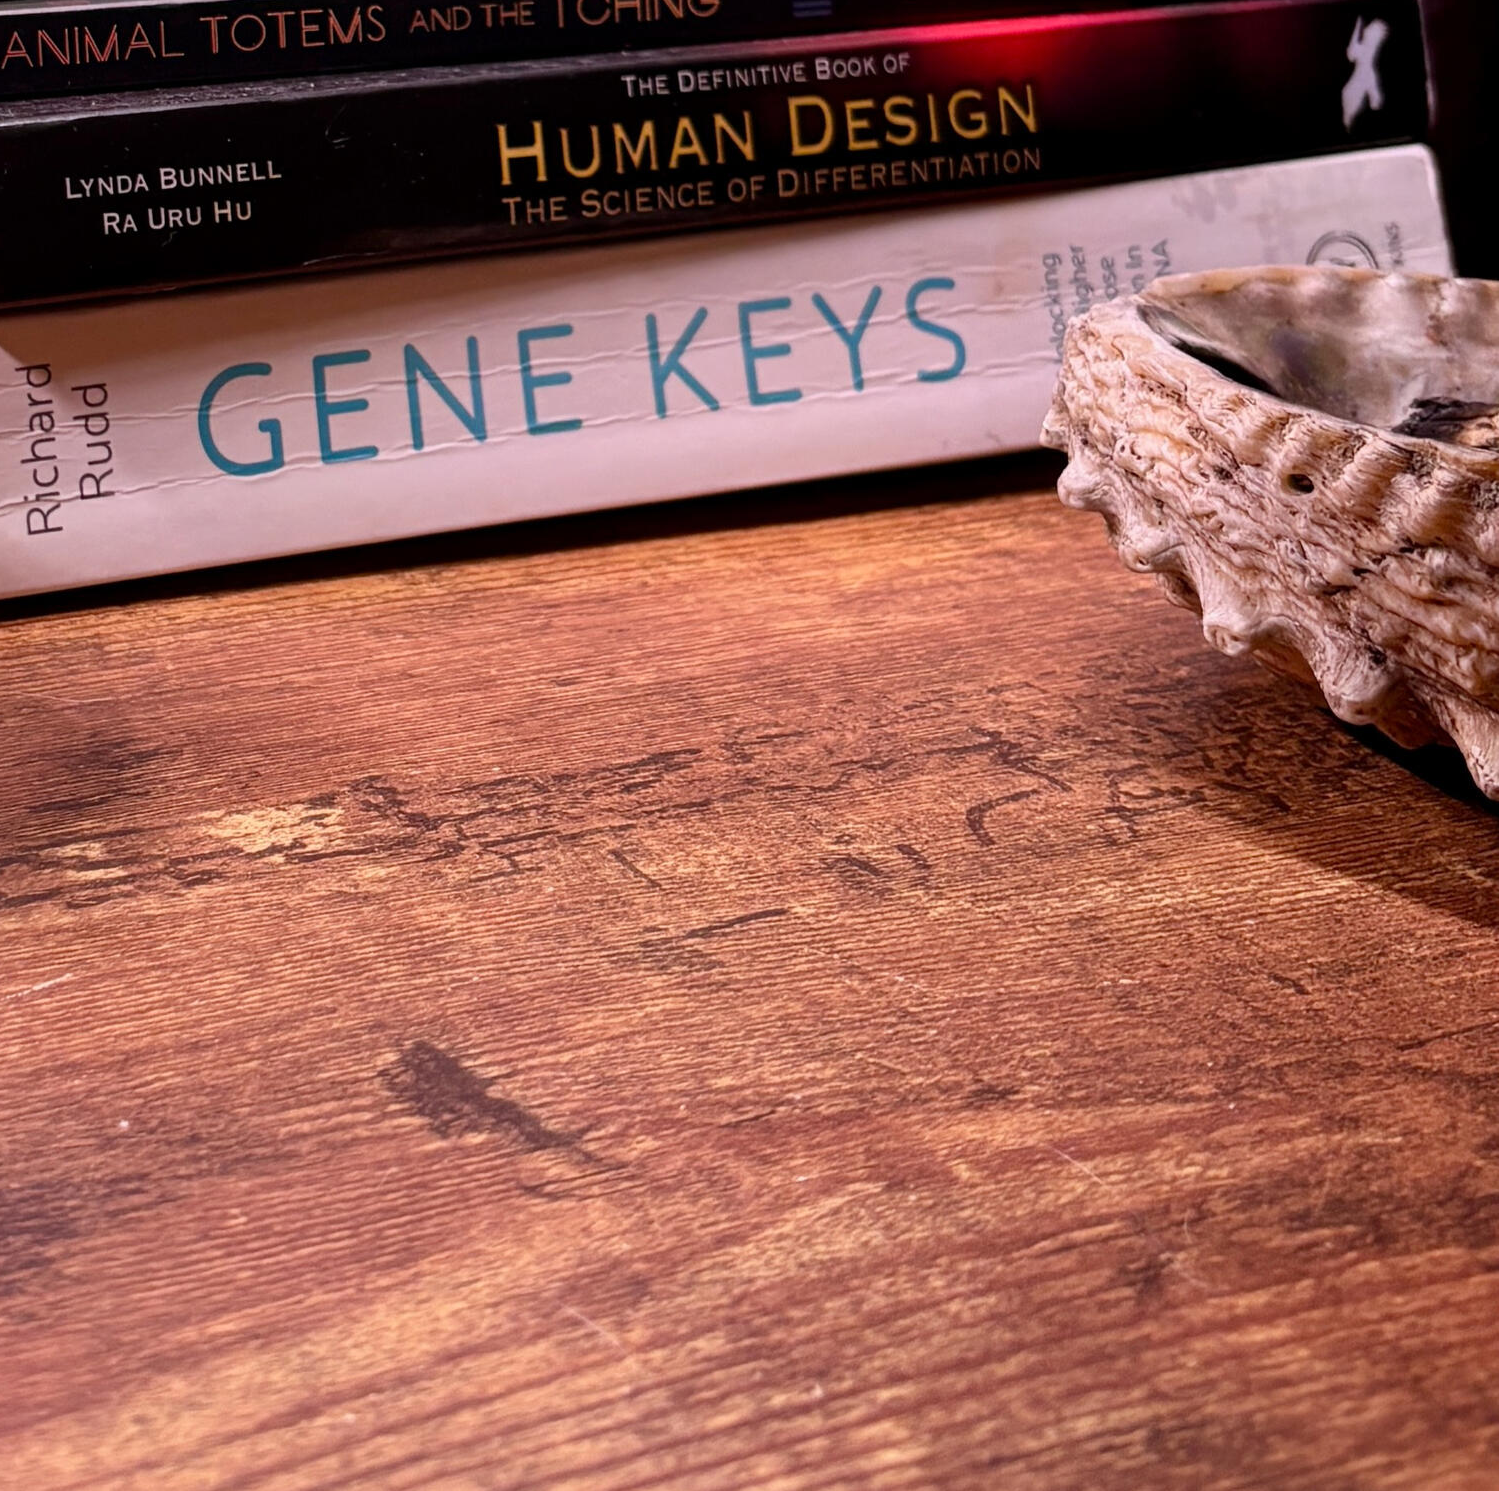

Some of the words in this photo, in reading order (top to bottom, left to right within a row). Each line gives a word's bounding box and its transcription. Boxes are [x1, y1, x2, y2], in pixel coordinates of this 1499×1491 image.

[1, 19, 185, 70] ANIMAL
[200, 6, 387, 56] TOTEMS
[409, 6, 472, 34] AND
[484, 0, 536, 28] THE
[15, 362, 63, 536] Richard
[71, 383, 115, 501] Rudd
[198, 324, 583, 477] GENE
[646, 276, 968, 420] KEYS
